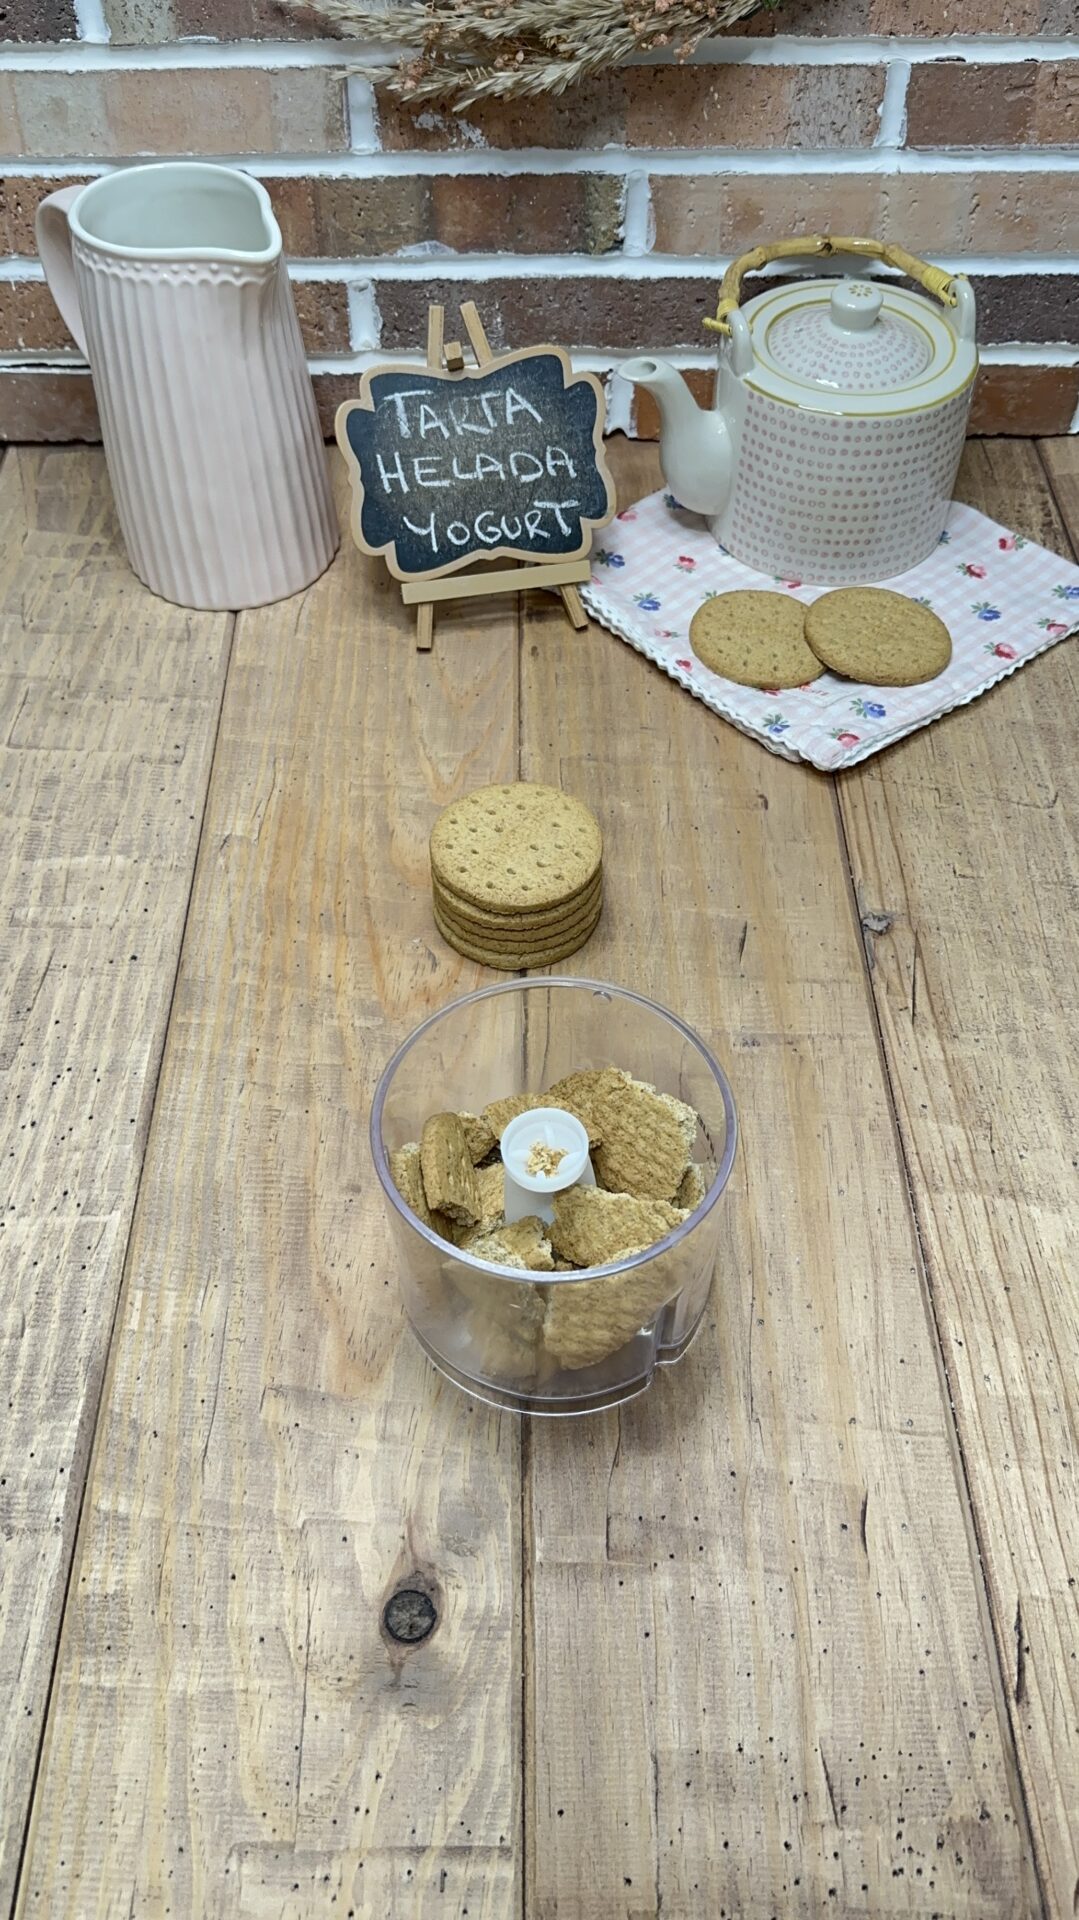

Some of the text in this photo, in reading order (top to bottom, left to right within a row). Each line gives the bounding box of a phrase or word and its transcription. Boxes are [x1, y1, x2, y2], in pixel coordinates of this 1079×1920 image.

[384, 388, 543, 439] TARTA
[376, 446, 577, 493] HELADA
[403, 500, 580, 553] YOGURT
